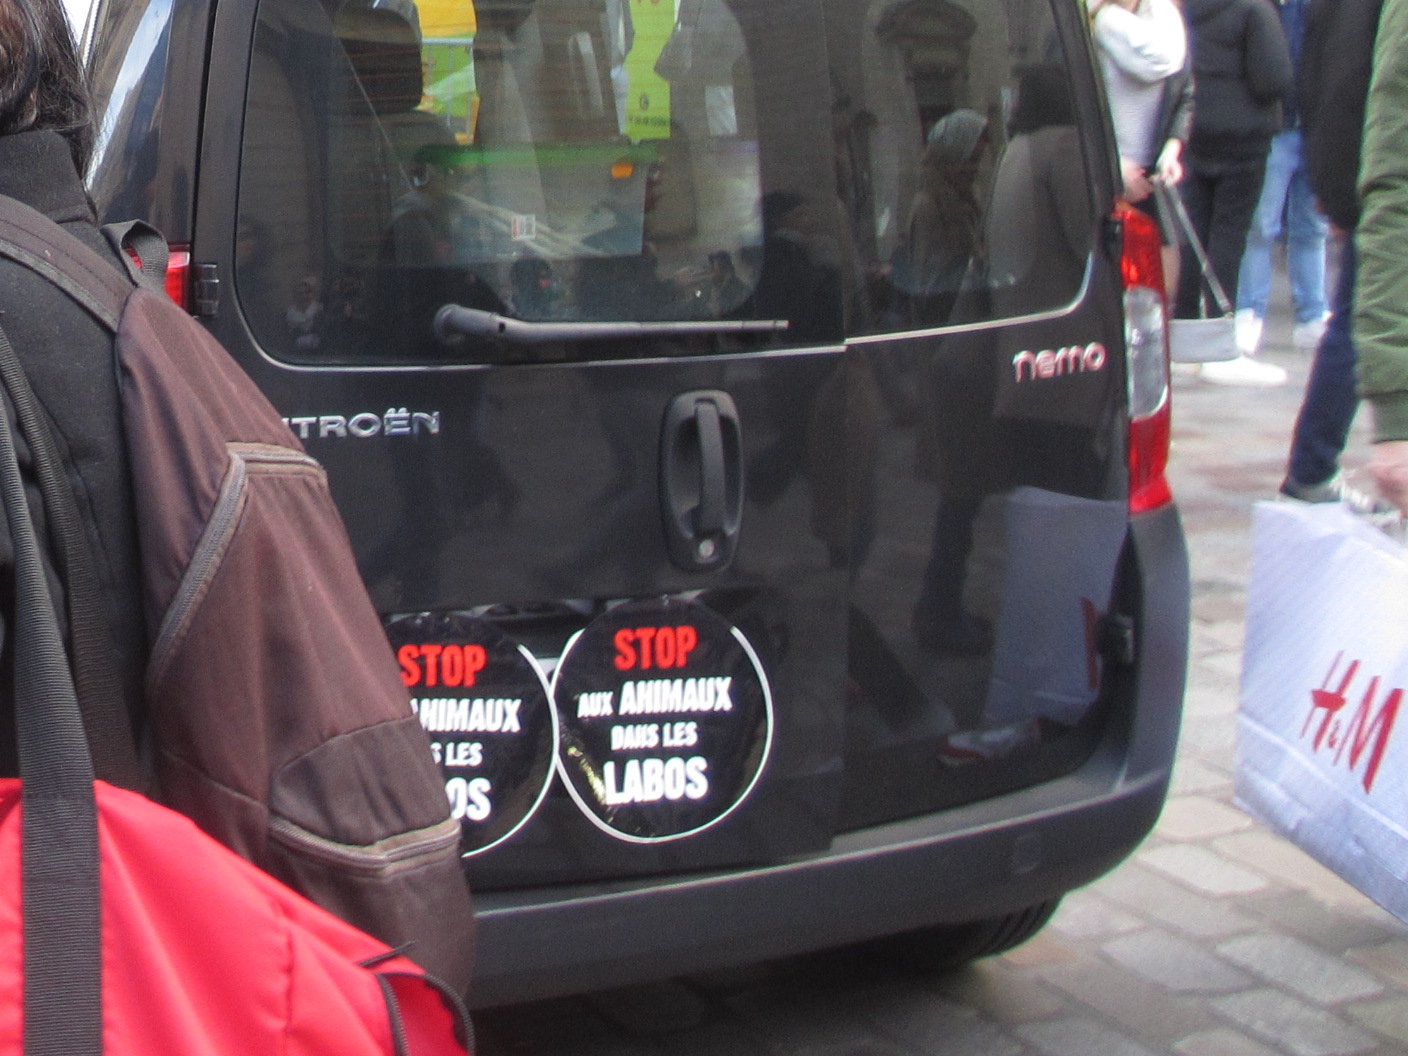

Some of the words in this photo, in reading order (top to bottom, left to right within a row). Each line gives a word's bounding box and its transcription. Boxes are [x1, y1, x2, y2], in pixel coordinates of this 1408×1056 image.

[1012, 341, 1108, 383] nemo
[397, 643, 488, 687] STOP
[613, 625, 699, 671] STOP
[409, 698, 522, 733] NIMAUX
[577, 690, 614, 719] AUX
[619, 676, 733, 716] ANIMAUX
[611, 723, 660, 751] DANS
[662, 721, 699, 748] LES
[1299, 651, 1405, 796] H&M
[445, 741, 484, 767] LES
[603, 755, 709, 806] LABOS
